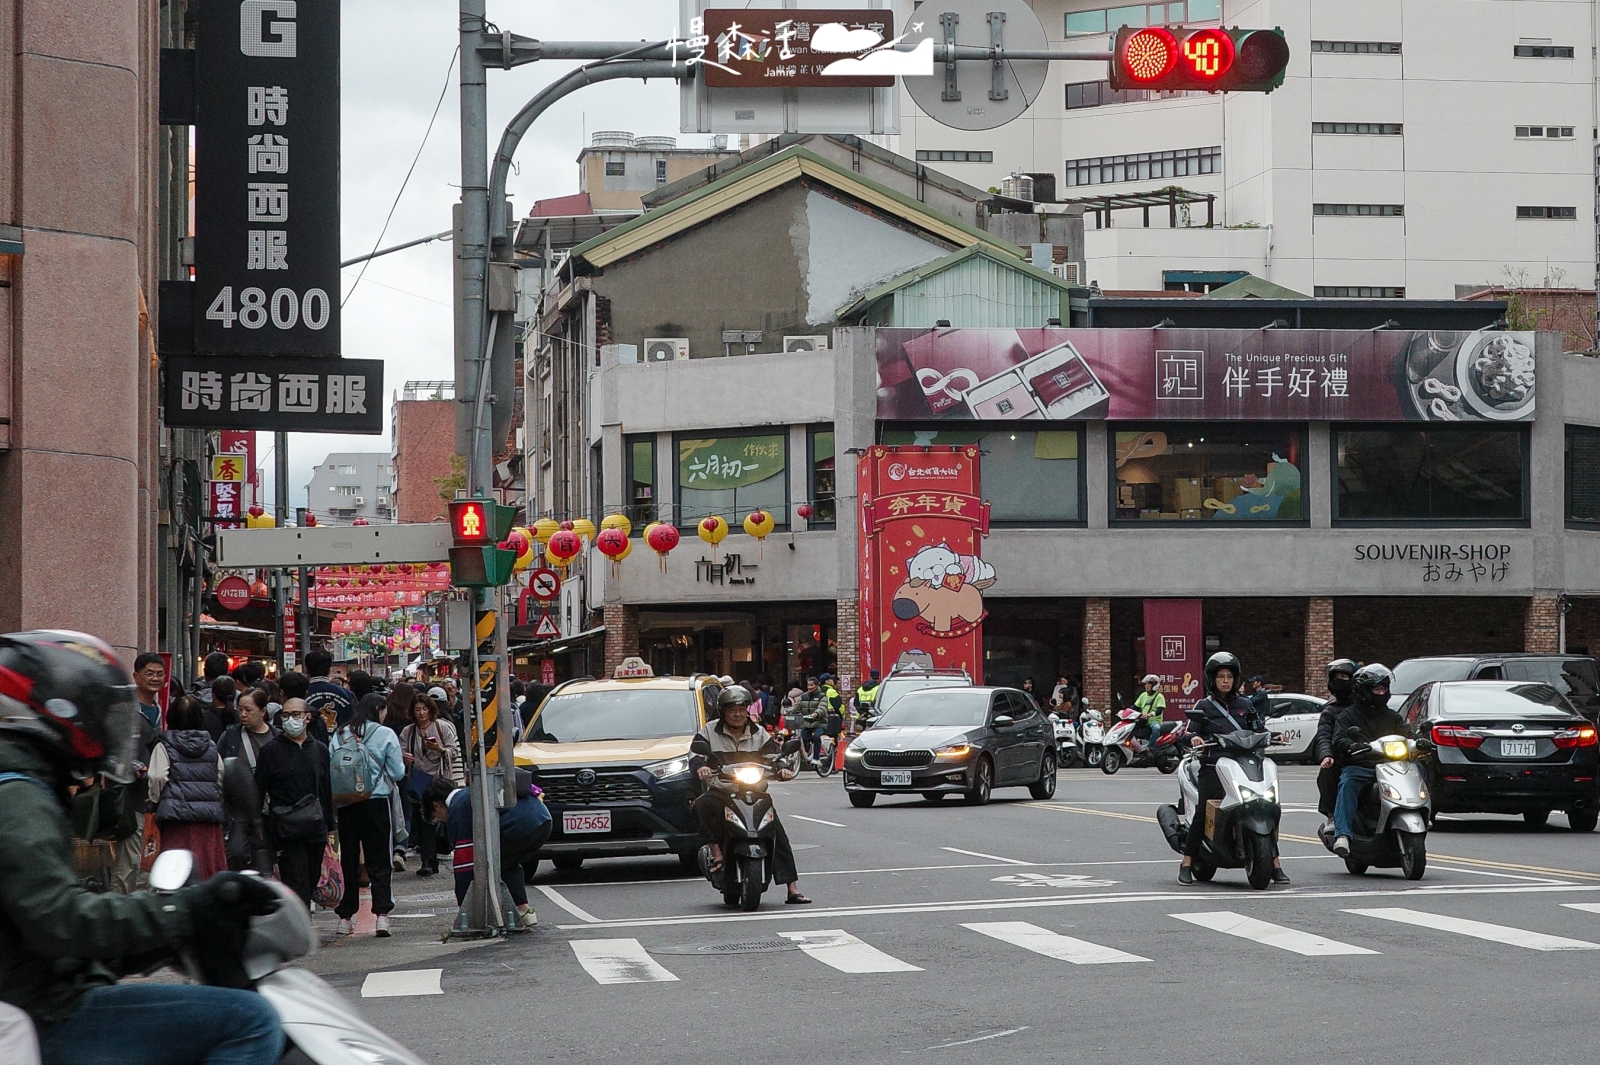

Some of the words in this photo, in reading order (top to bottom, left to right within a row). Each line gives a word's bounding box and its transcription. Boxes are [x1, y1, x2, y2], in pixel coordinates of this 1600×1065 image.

[1184, 38, 1219, 75] 40
[247, 86, 289, 270] 時尚西服
[206, 286, 331, 330] 4800
[1224, 353, 1243, 363] The
[1246, 353, 1281, 365] Unique
[1284, 353, 1326, 363] Precious
[1329, 353, 1348, 363] Gift
[181, 371, 367, 414] 時尚西服
[1221, 366, 1350, 398] 伴手好禮
[216, 459, 240, 481] 香
[688, 454, 760, 483] 六月初一
[1355, 544, 1512, 561] SOUVENIR-SHOP
[693, 553, 759, 586] 六月初一
[1422, 562, 1511, 583] おみやげ
[1159, 674, 1182, 683] 月初一
[1502, 743, 1535, 756] 1717-H7
[563, 816, 611, 831] TDZ-5652
